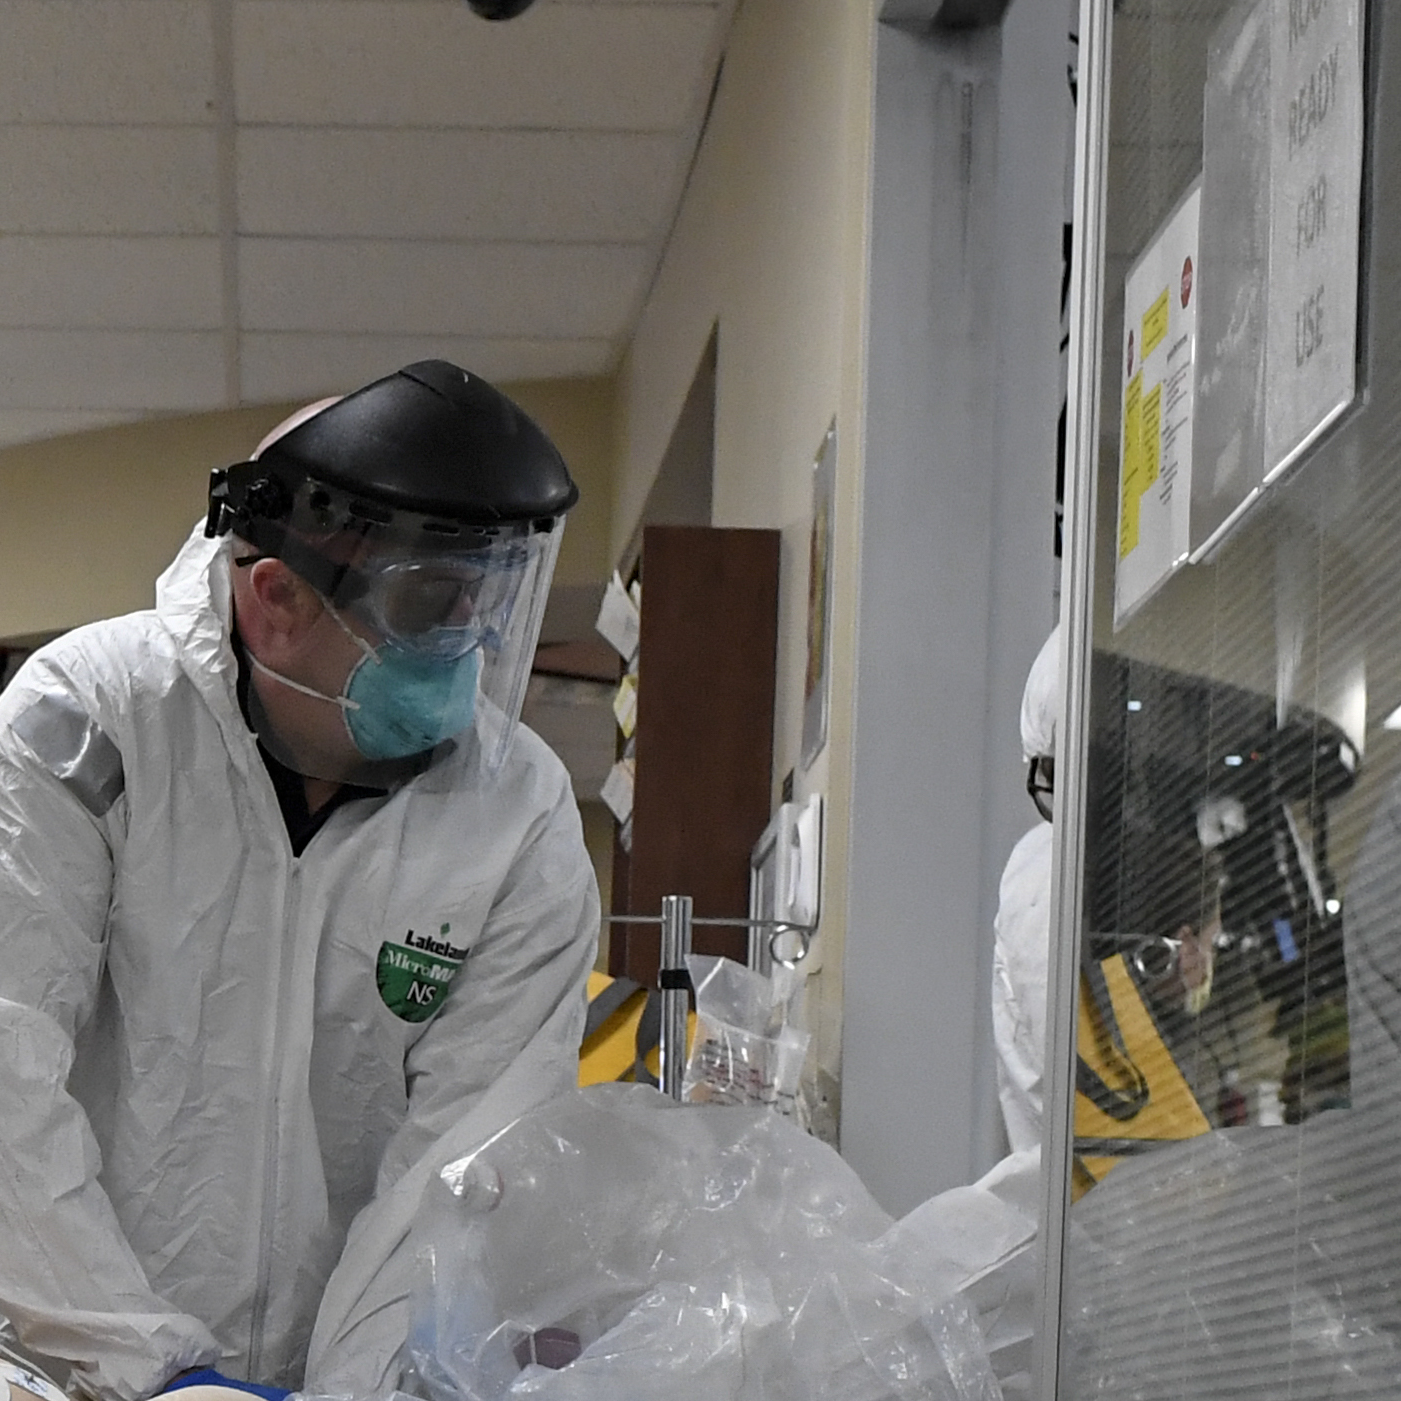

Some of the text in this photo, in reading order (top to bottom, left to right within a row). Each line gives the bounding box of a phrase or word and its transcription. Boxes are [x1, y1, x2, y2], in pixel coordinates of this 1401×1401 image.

[1288, 43, 1339, 161] READY
[1296, 174, 1327, 257] FOR
[1296, 284, 1325, 368] USE
[406, 980, 437, 1006] NS
